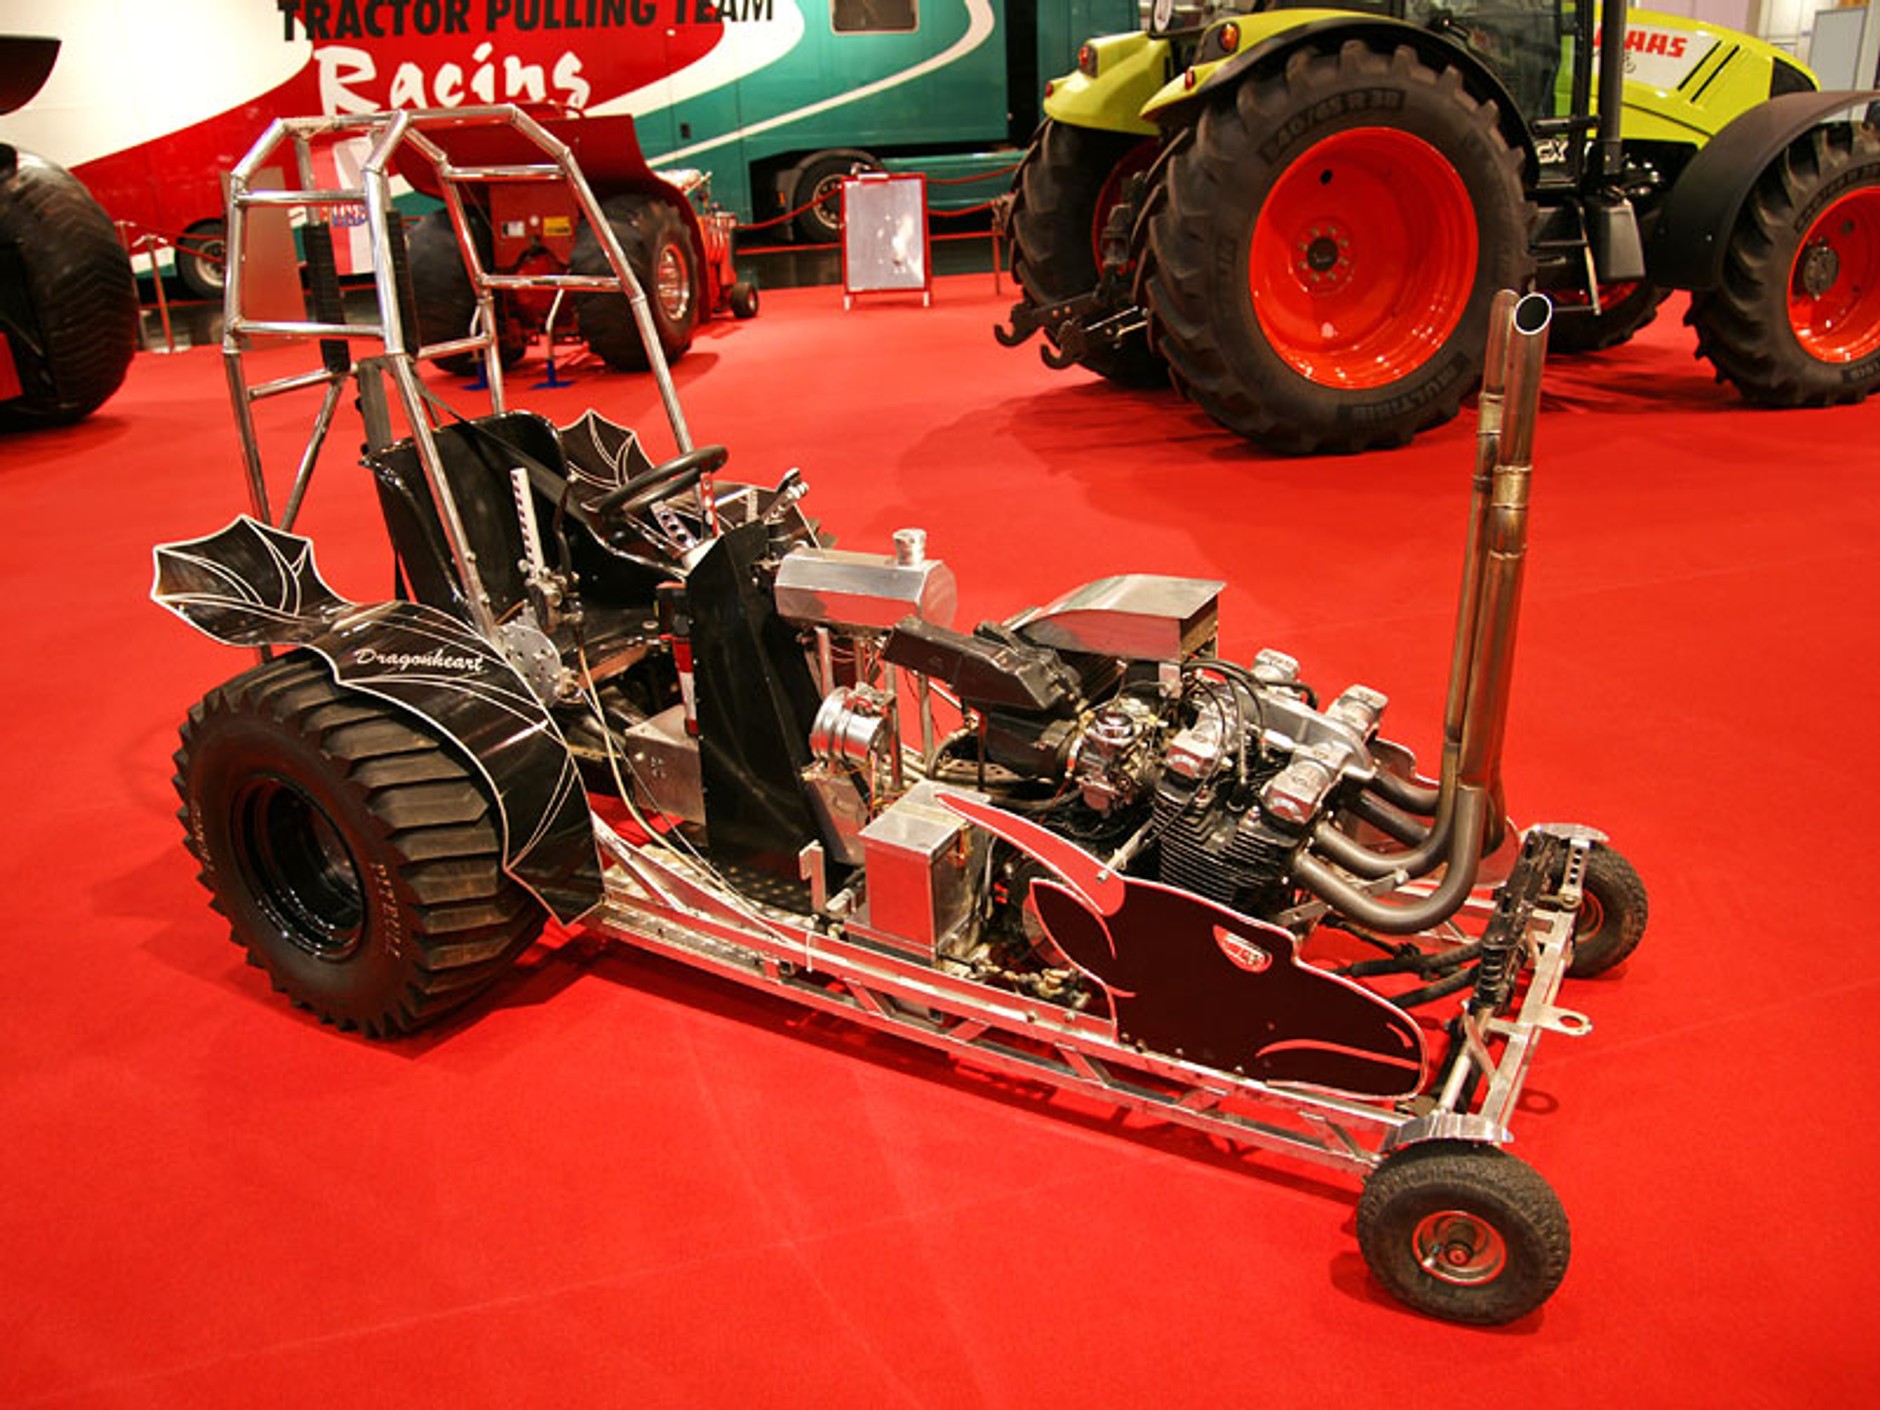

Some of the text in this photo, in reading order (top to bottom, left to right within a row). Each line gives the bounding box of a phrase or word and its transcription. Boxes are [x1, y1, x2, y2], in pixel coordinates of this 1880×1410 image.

[278, 0, 773, 42] TRACTOR PULLING TEAM
[352, 643, 488, 677] Dragonheart
